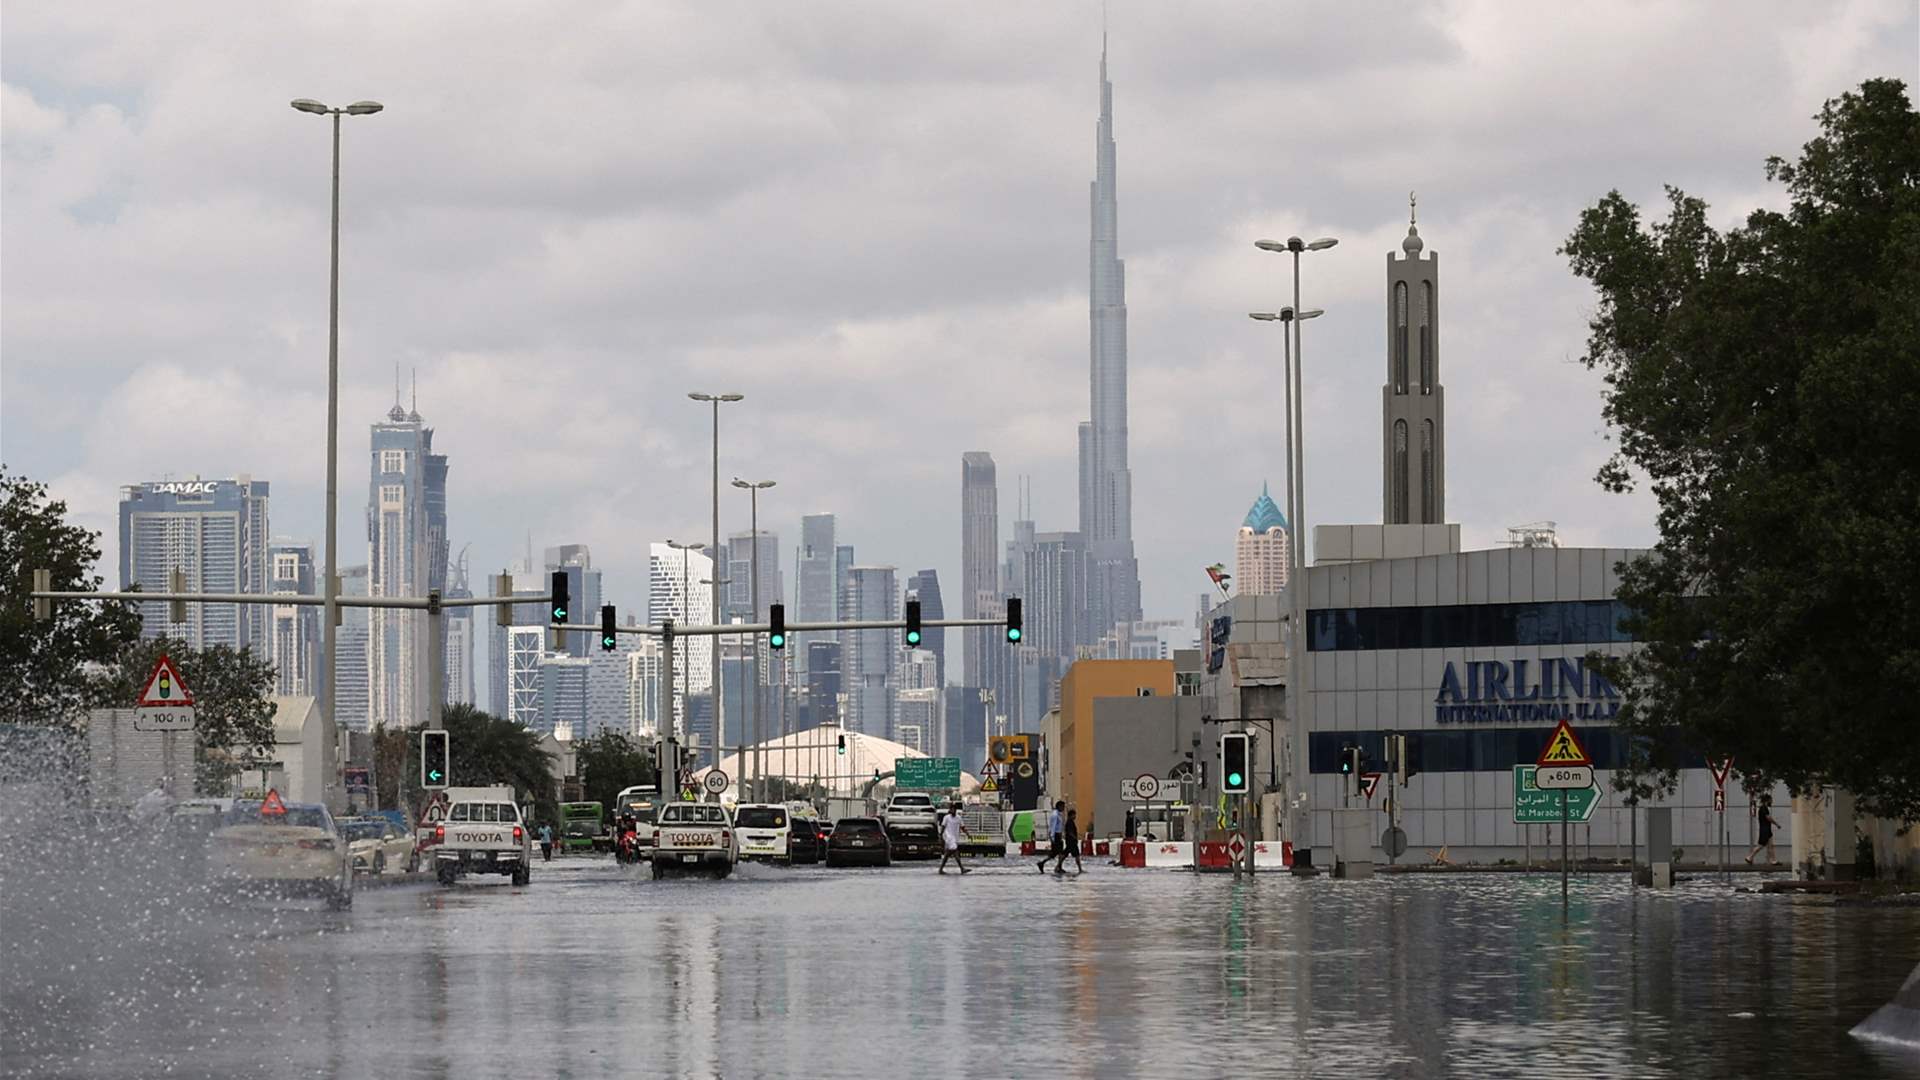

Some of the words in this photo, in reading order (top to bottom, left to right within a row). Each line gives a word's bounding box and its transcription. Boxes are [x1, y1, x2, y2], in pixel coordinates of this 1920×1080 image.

[152, 482, 217, 493] DAMAC
[153, 713, 174, 723] 100
[1436, 703, 1574, 723] INTERNATIONAL
[710, 777, 723, 787] 60
[1140, 782, 1154, 791] 60
[1569, 808, 1580, 817] St
[456, 832, 503, 842] TOYOTA
[671, 833, 713, 842] TOYOTA
